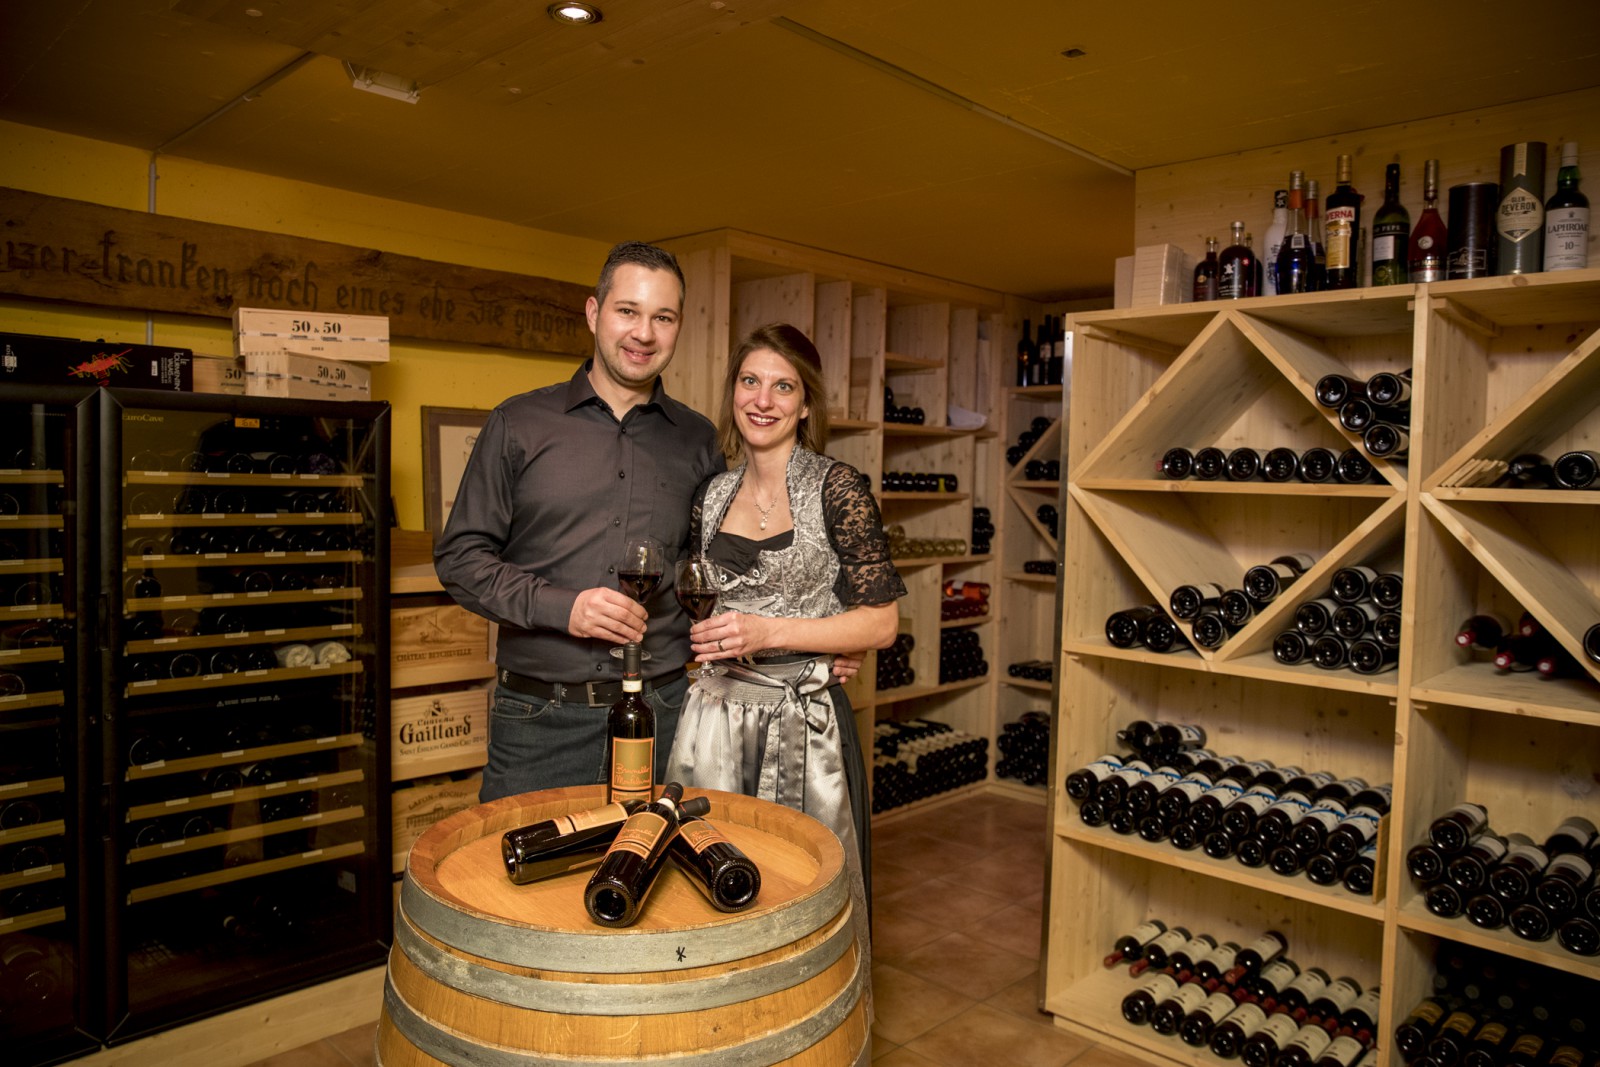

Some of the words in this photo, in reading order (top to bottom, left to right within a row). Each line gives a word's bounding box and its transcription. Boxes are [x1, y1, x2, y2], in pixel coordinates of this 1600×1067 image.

[1501, 201, 1537, 215] DEVERON
[1326, 209, 1354, 221] VERNA
[1564, 241, 1574, 250] 10
[291, 320, 311, 333] 50
[323, 321, 342, 334] 50
[225, 368, 242, 380] 50
[317, 365, 329, 378] 50
[335, 367, 346, 380] 50
[122, 413, 164, 423] EuroCave
[399, 714, 472, 745] Gaillard
